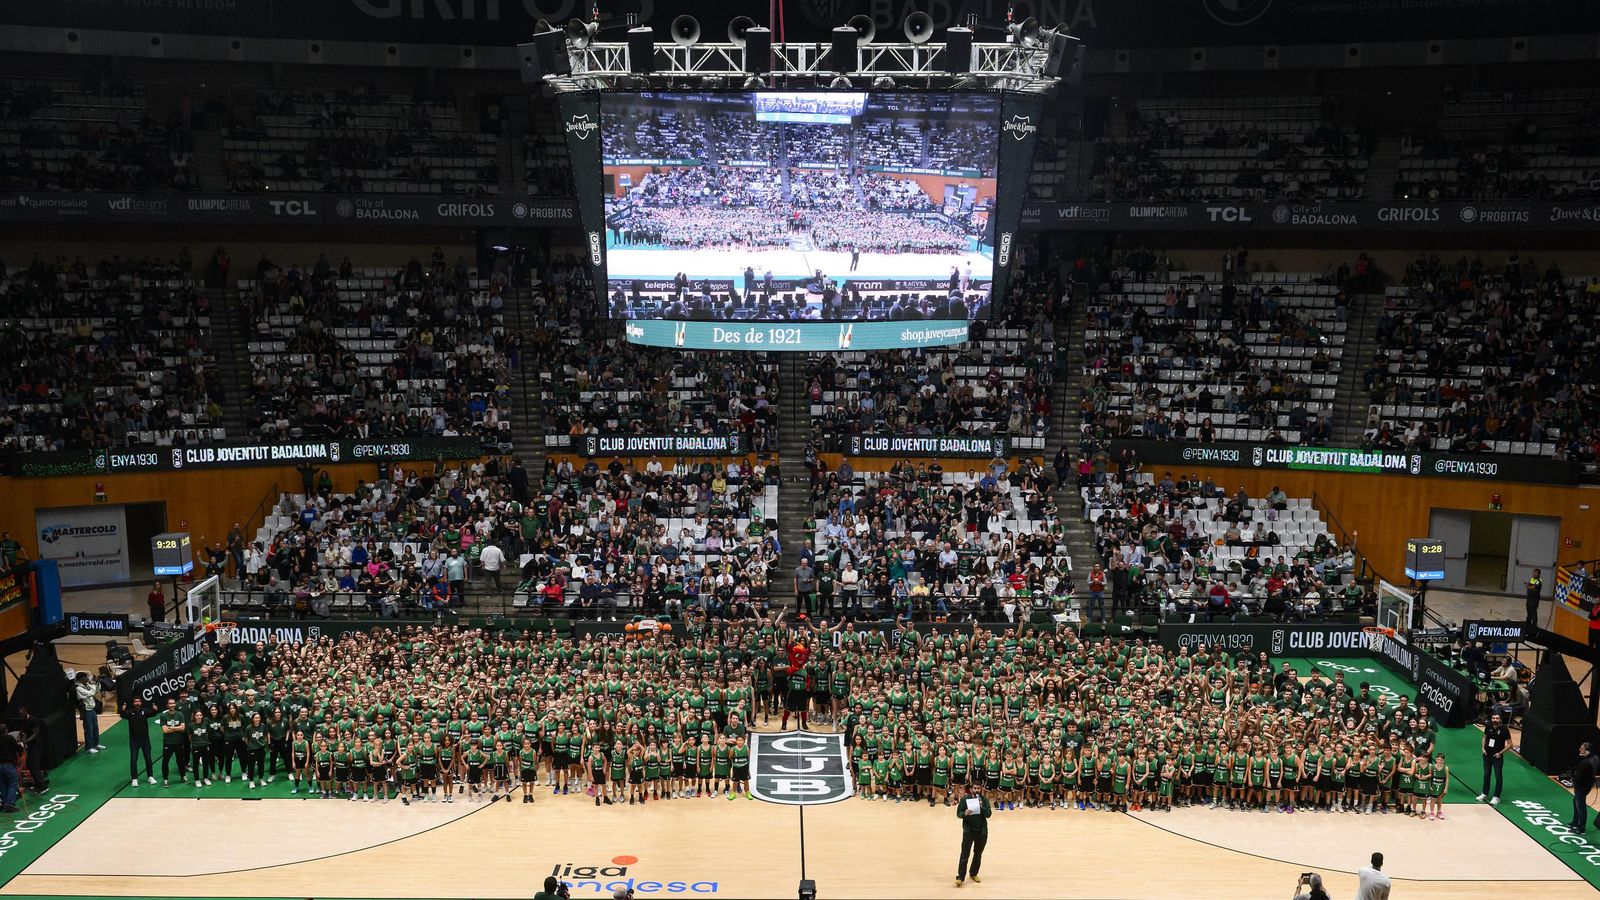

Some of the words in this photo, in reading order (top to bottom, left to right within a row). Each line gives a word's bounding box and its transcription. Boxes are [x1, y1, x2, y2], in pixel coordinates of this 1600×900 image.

[269, 200, 316, 216] TCL
[355, 199, 374, 210] City
[438, 204, 494, 217] GRIFOLS
[356, 208, 420, 220] BADALONA
[530, 207, 573, 218] PROBITAS
[1206, 207, 1252, 222] TCL
[1378, 208, 1440, 221] GRIFOLS
[1480, 211, 1529, 222] PROBITAS
[1292, 214, 1357, 225] BADALONA
[713, 328, 740, 343] Des
[745, 328, 764, 344] de
[768, 328, 802, 344] 1921
[354, 444, 410, 457] @PENYA1930
[600, 438, 624, 450] CLUB
[626, 438, 674, 450] JOVENTUT
[676, 438, 727, 450] BADALONA
[864, 438, 889, 451] CLUB
[890, 438, 938, 451] JOVENTUT
[940, 438, 991, 452] BADALONA
[186, 450, 214, 463] CLUB
[216, 446, 268, 462] JOVENTUT
[272, 444, 326, 460] BADALONA
[1183, 448, 1240, 462] @PENYA1930
[1266, 450, 1293, 463] CLUB
[1295, 450, 1347, 466] JOVENTUT
[1349, 452, 1407, 469] BADALONA
[1435, 460, 1498, 475] @PENYA1930
[52, 525, 116, 536] MASTERCOLD
[156, 540, 176, 548] 9:28
[80, 620, 122, 630] PENYA.COM
[1478, 626, 1521, 637] PENYA.COM
[150, 630, 184, 638] endesa
[1290, 631, 1324, 648] CLUB
[1316, 660, 1361, 673] acb
[1420, 682, 1453, 713] endesa
[552, 863, 628, 879] liga
